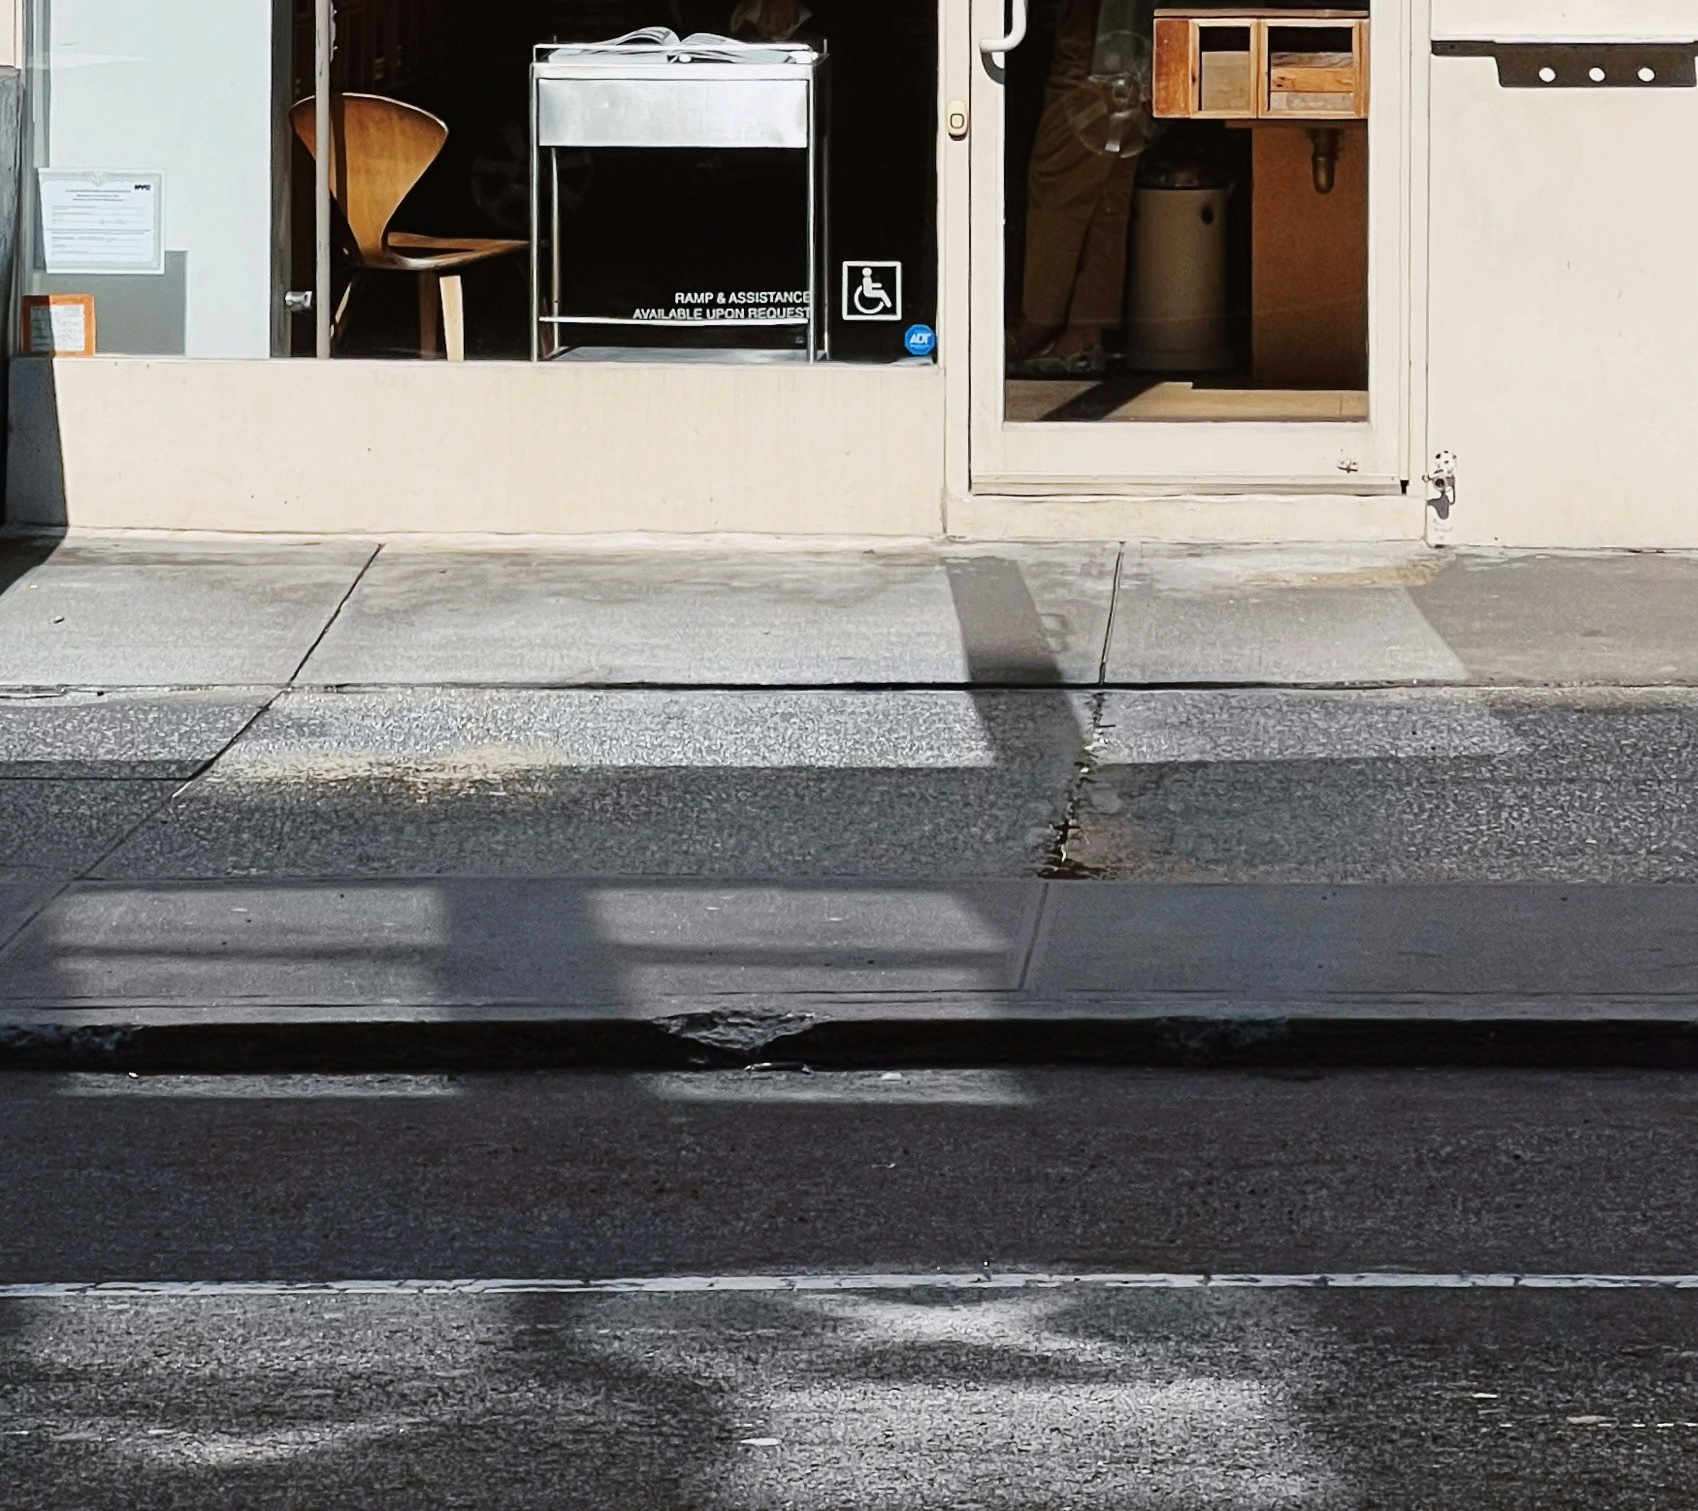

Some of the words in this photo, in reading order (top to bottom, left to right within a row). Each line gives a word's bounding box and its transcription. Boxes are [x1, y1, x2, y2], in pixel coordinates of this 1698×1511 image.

[675, 292, 714, 304] RAMP
[716, 292, 726, 304] &
[728, 291, 810, 304] ASSISTANCE
[633, 308, 703, 320] AVAILABLE
[706, 308, 744, 319] UPON
[748, 307, 810, 319] REQUEST
[909, 333, 931, 345] ADT
